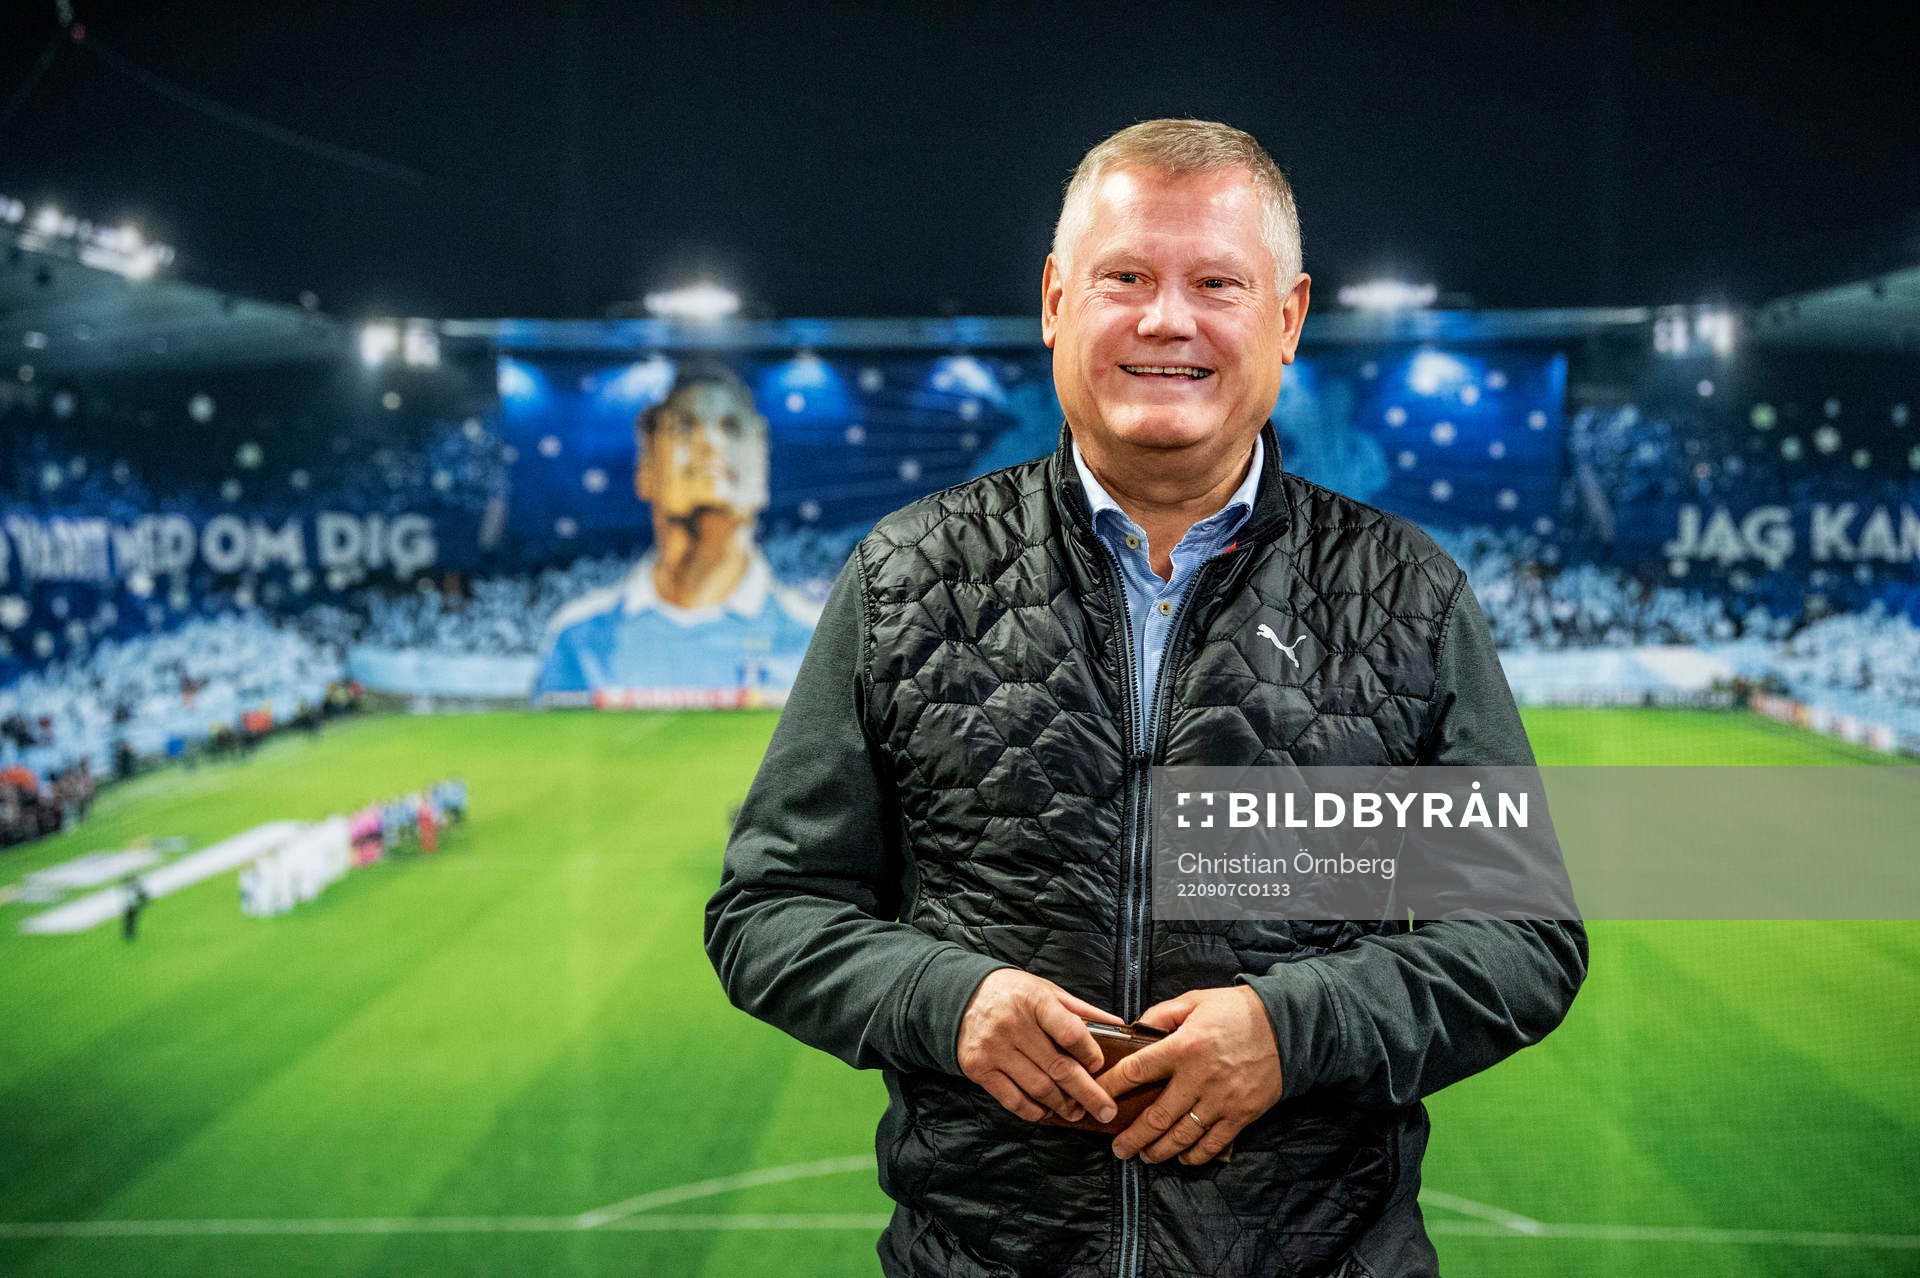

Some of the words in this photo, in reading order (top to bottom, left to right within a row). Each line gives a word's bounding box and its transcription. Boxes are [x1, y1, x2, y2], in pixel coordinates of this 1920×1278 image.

[204, 513, 304, 572] OM
[316, 512, 435, 577] DIG
[1666, 503, 1794, 570] JAG
